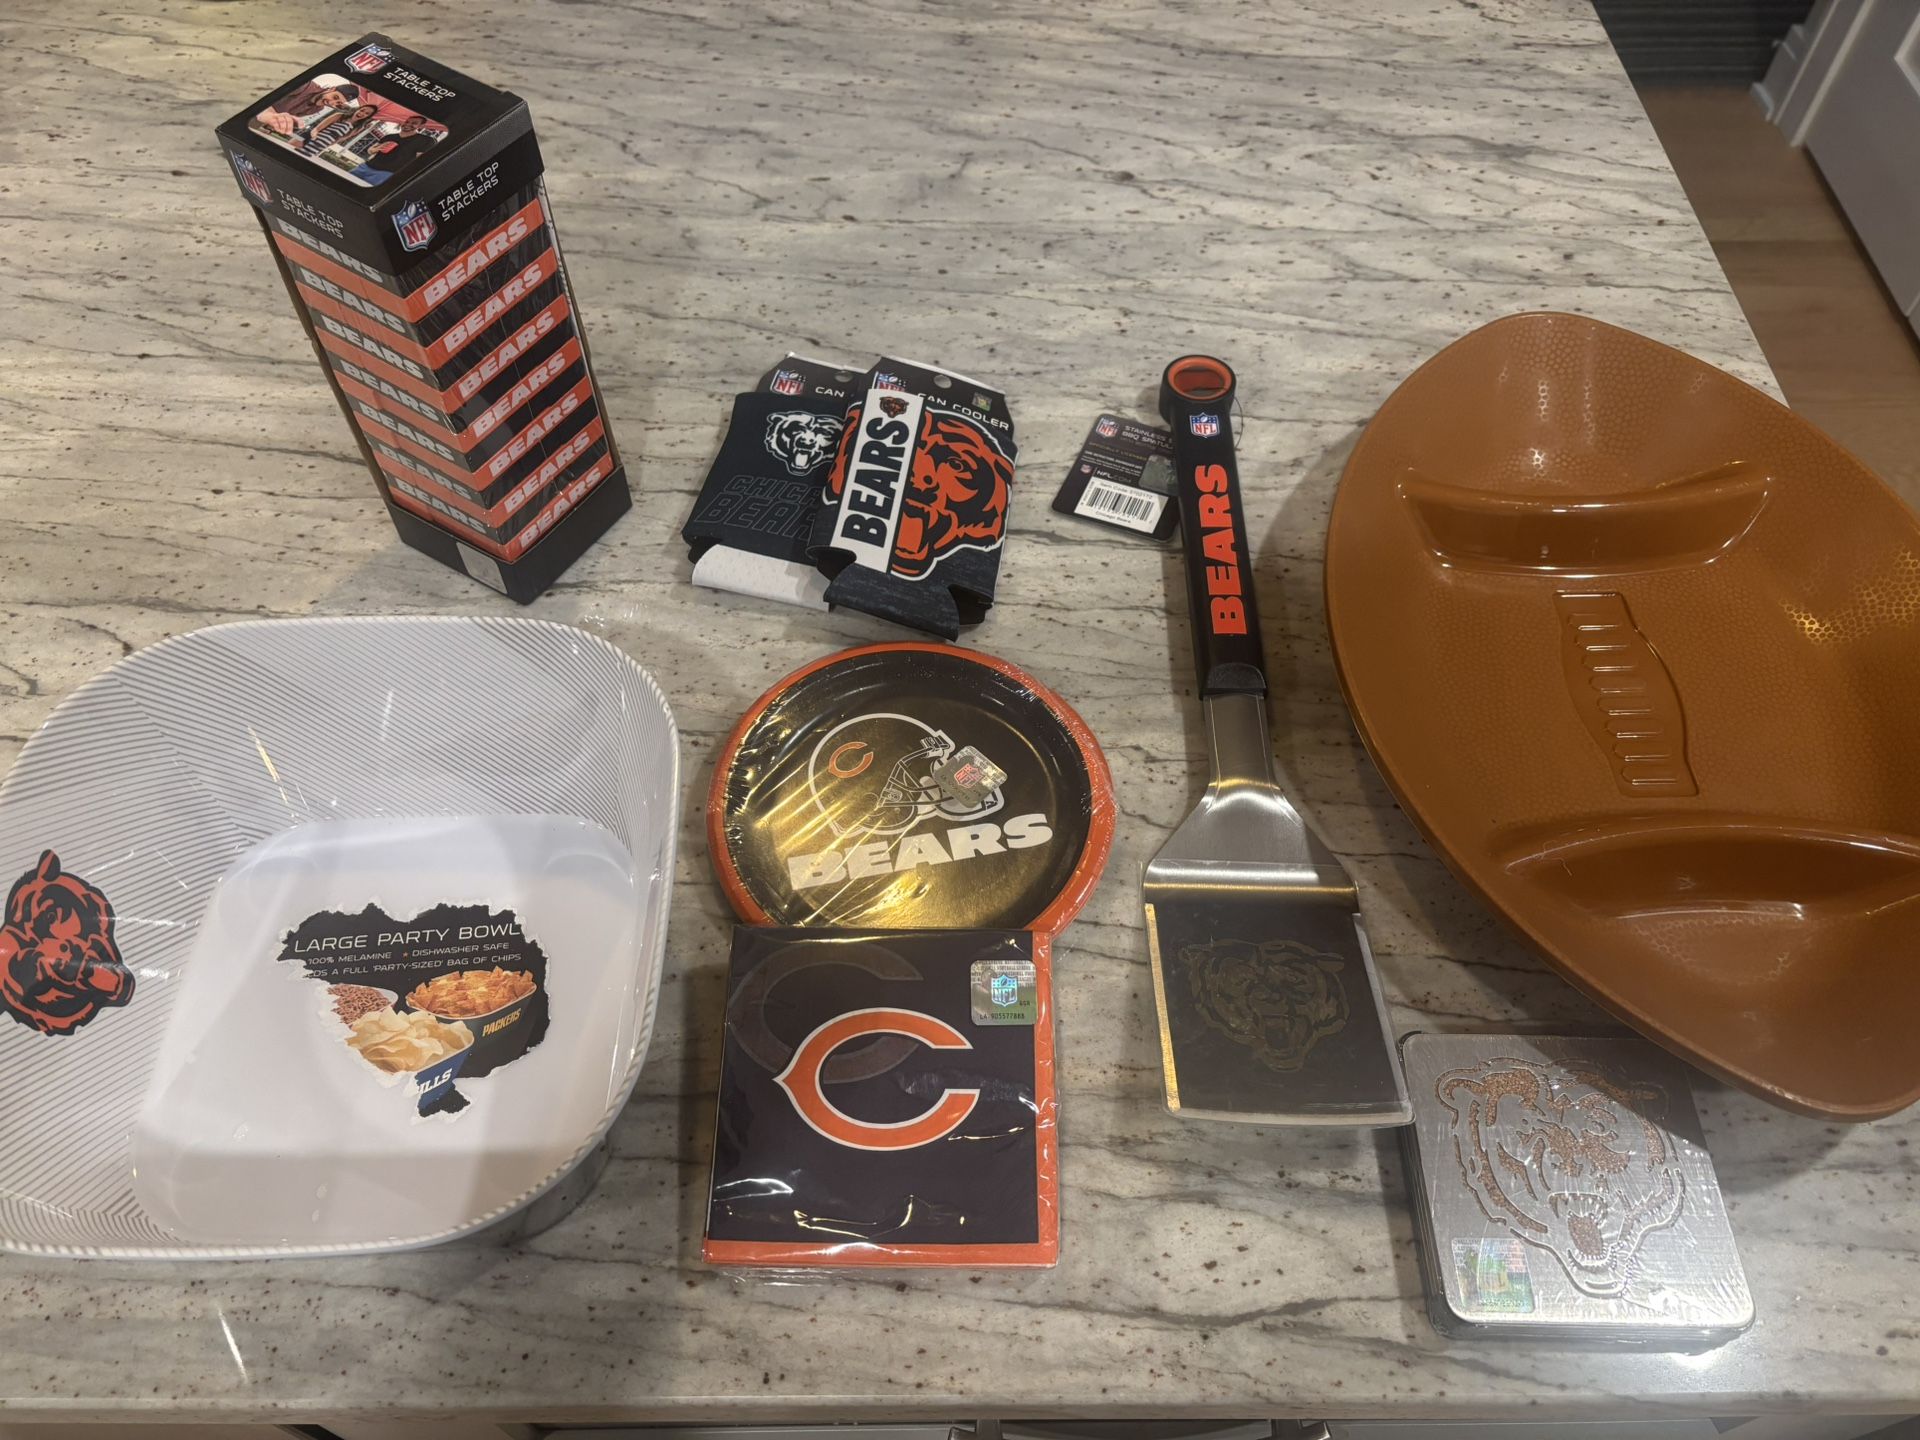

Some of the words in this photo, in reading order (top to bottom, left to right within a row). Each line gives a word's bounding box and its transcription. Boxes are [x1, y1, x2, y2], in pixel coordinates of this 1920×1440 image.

[383, 72, 443, 102] STACKERS
[394, 67, 430, 87] TABLE
[432, 84, 456, 98] TOP
[277, 188, 315, 216] TABLE
[318, 210, 343, 228] TOP
[438, 180, 474, 209] TABLE
[476, 162, 499, 180] TOP
[441, 175, 499, 222] STACKERS
[281, 200, 343, 239] STACKERS
[276, 217, 383, 283] BEARS
[423, 216, 527, 307] BEARS
[300, 267, 406, 333] BEARS
[443, 263, 542, 353] BEARS
[321, 314, 424, 379] BEARS
[458, 311, 554, 399] BEARS
[340, 359, 439, 422] BEARS
[473, 352, 566, 438] BEARS
[815, 386, 845, 398] CAN
[952, 404, 1009, 431] COOLER
[358, 400, 455, 461] BEARS
[489, 392, 578, 477] BEARS
[1142, 436, 1174, 450] SPATUL
[378, 443, 472, 500] BEARS
[503, 431, 590, 513] BEARS
[723, 475, 823, 505] CHICA
[840, 417, 910, 549] BEARS
[394, 477, 486, 534] BEARS
[519, 467, 601, 548] BEARS
[694, 492, 818, 542] BEAR
[1194, 463, 1248, 634] BEARS
[828, 740, 874, 778] C
[788, 813, 1054, 891] BEARS
[294, 934, 369, 953] LARGE
[377, 928, 450, 946] PARTY
[458, 922, 521, 940] BOWL
[308, 955, 335, 965] 100%
[338, 951, 393, 963] MELAMINE
[412, 944, 479, 957] DISHWASHER
[483, 942, 510, 952] SAFE
[331, 967, 339, 976] A
[343, 966, 369, 975] FULL
[447, 957, 469, 967] BAG
[472, 956, 488, 965] OF
[491, 953, 522, 963] CHIPS
[481, 1008, 521, 1037] PACKERS
[418, 1068, 453, 1094] ILLS
[773, 1006, 981, 1151] C
